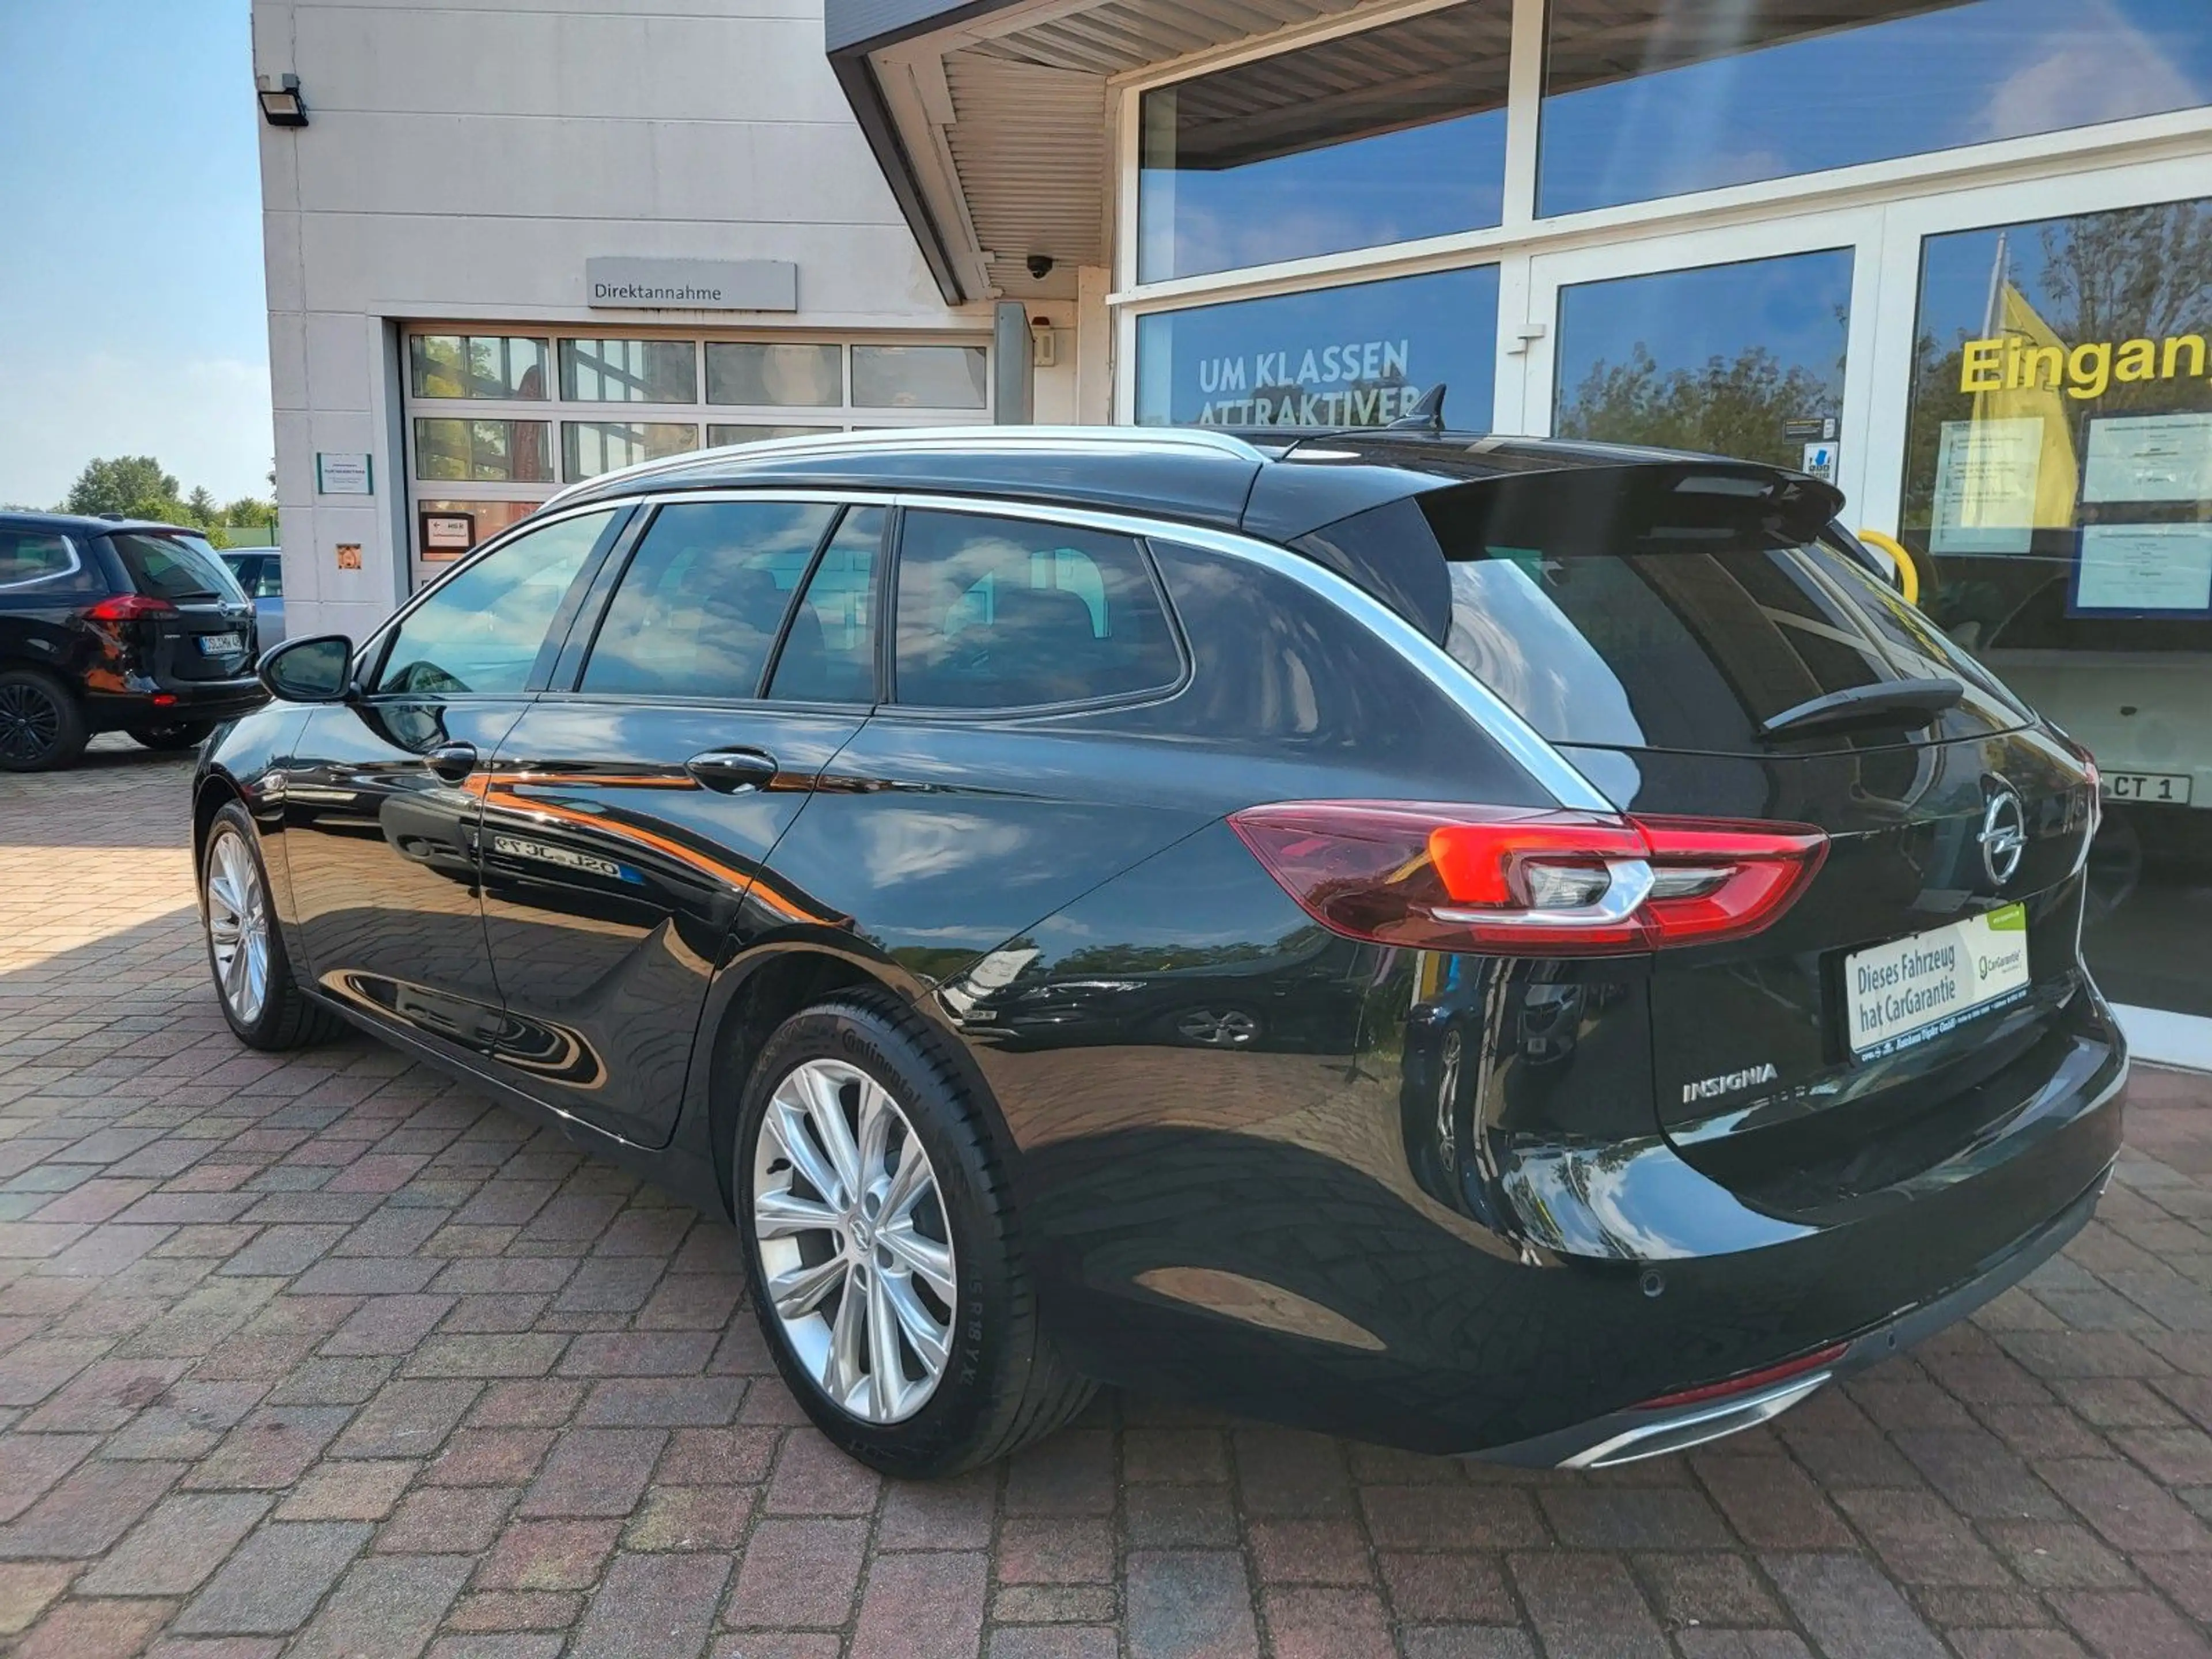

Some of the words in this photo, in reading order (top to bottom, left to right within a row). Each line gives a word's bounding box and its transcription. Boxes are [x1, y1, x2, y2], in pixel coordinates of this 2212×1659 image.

[594, 283, 722, 301] Direktannahme
[1199, 357, 1247, 393] UM
[1255, 339, 1408, 388] KLASSEN
[1960, 333, 2212, 399] Eingan
[2114, 775, 2147, 797] CT
[2157, 779, 2173, 800] 1
[1858, 963, 1899, 995] Dieses
[1902, 944, 1955, 980] Fahrzeug
[1859, 1001, 1884, 1032] hat
[1885, 975, 1956, 1022] CarGarantie
[842, 1028, 922, 1104] Continental
[1683, 1063, 1778, 1104] INSIGNIA
